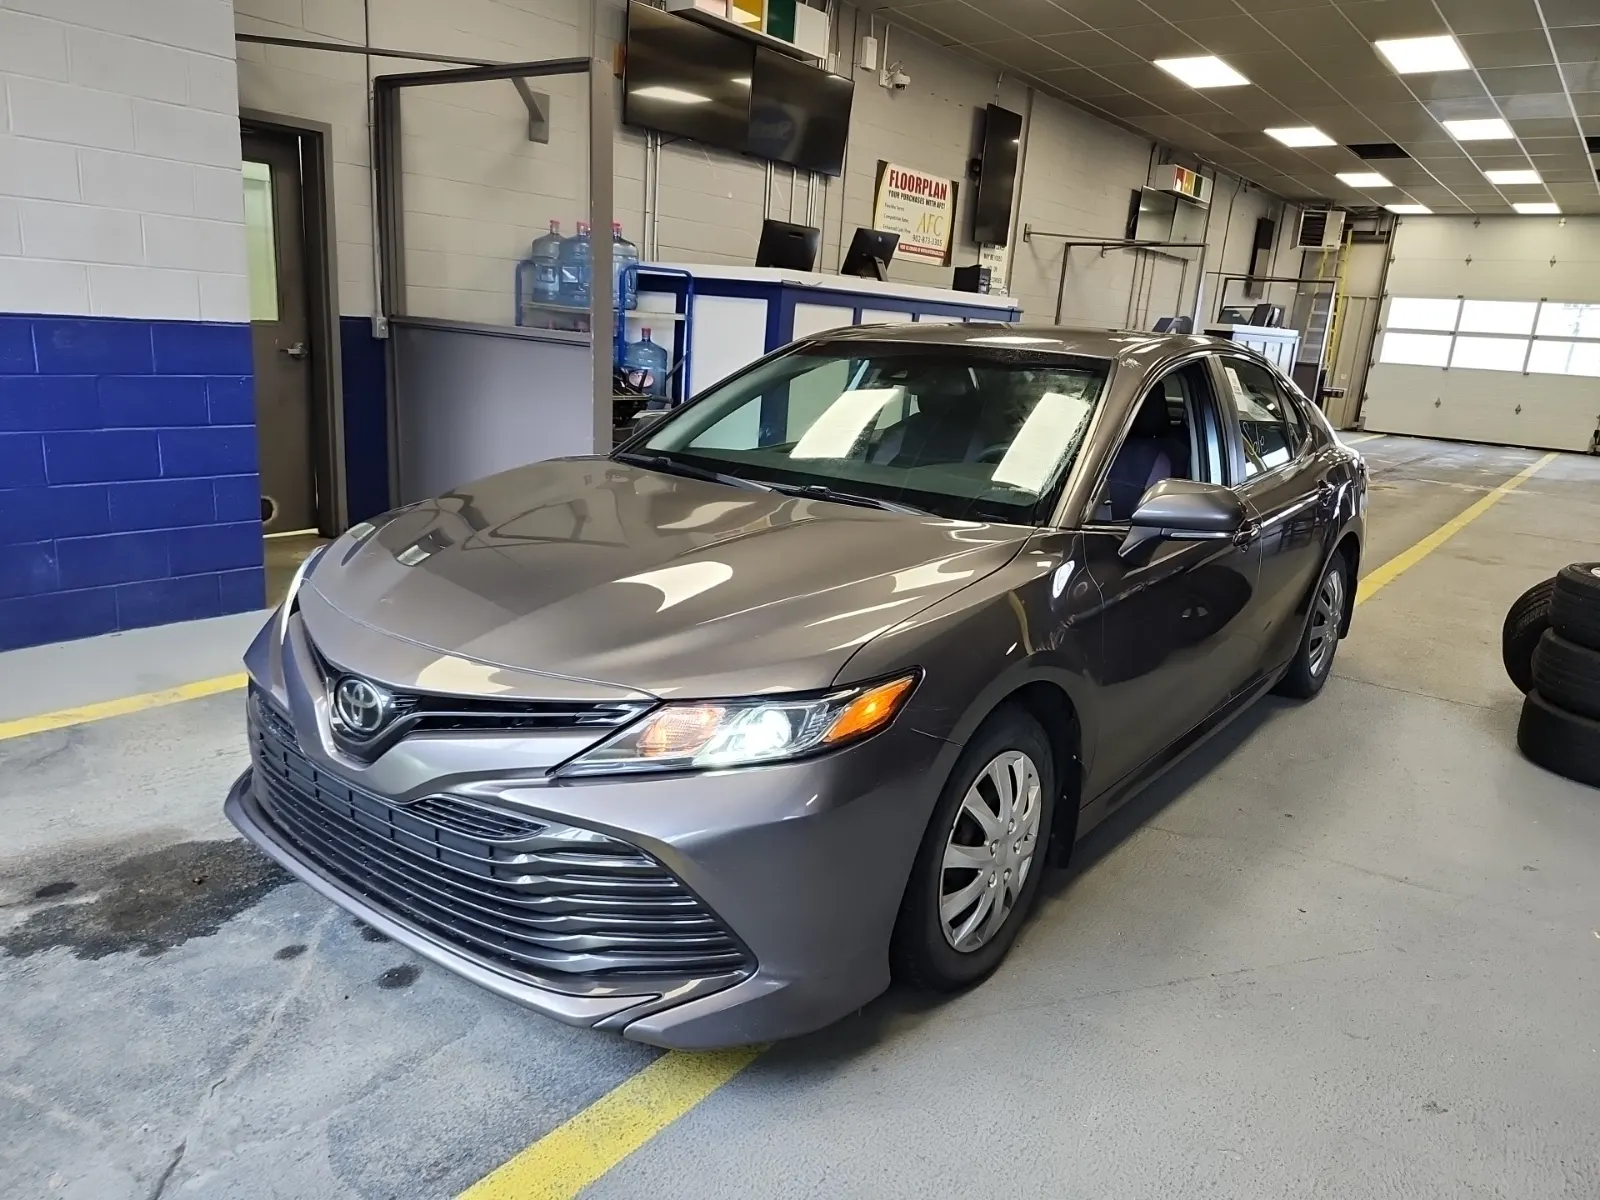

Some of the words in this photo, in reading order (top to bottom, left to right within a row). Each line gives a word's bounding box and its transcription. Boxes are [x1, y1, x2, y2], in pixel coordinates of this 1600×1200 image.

[888, 190, 900, 199] YOUR
[900, 192, 925, 205] PURCHASES
[889, 169, 947, 201] FLOORPLAN
[916, 211, 944, 237] AFC
